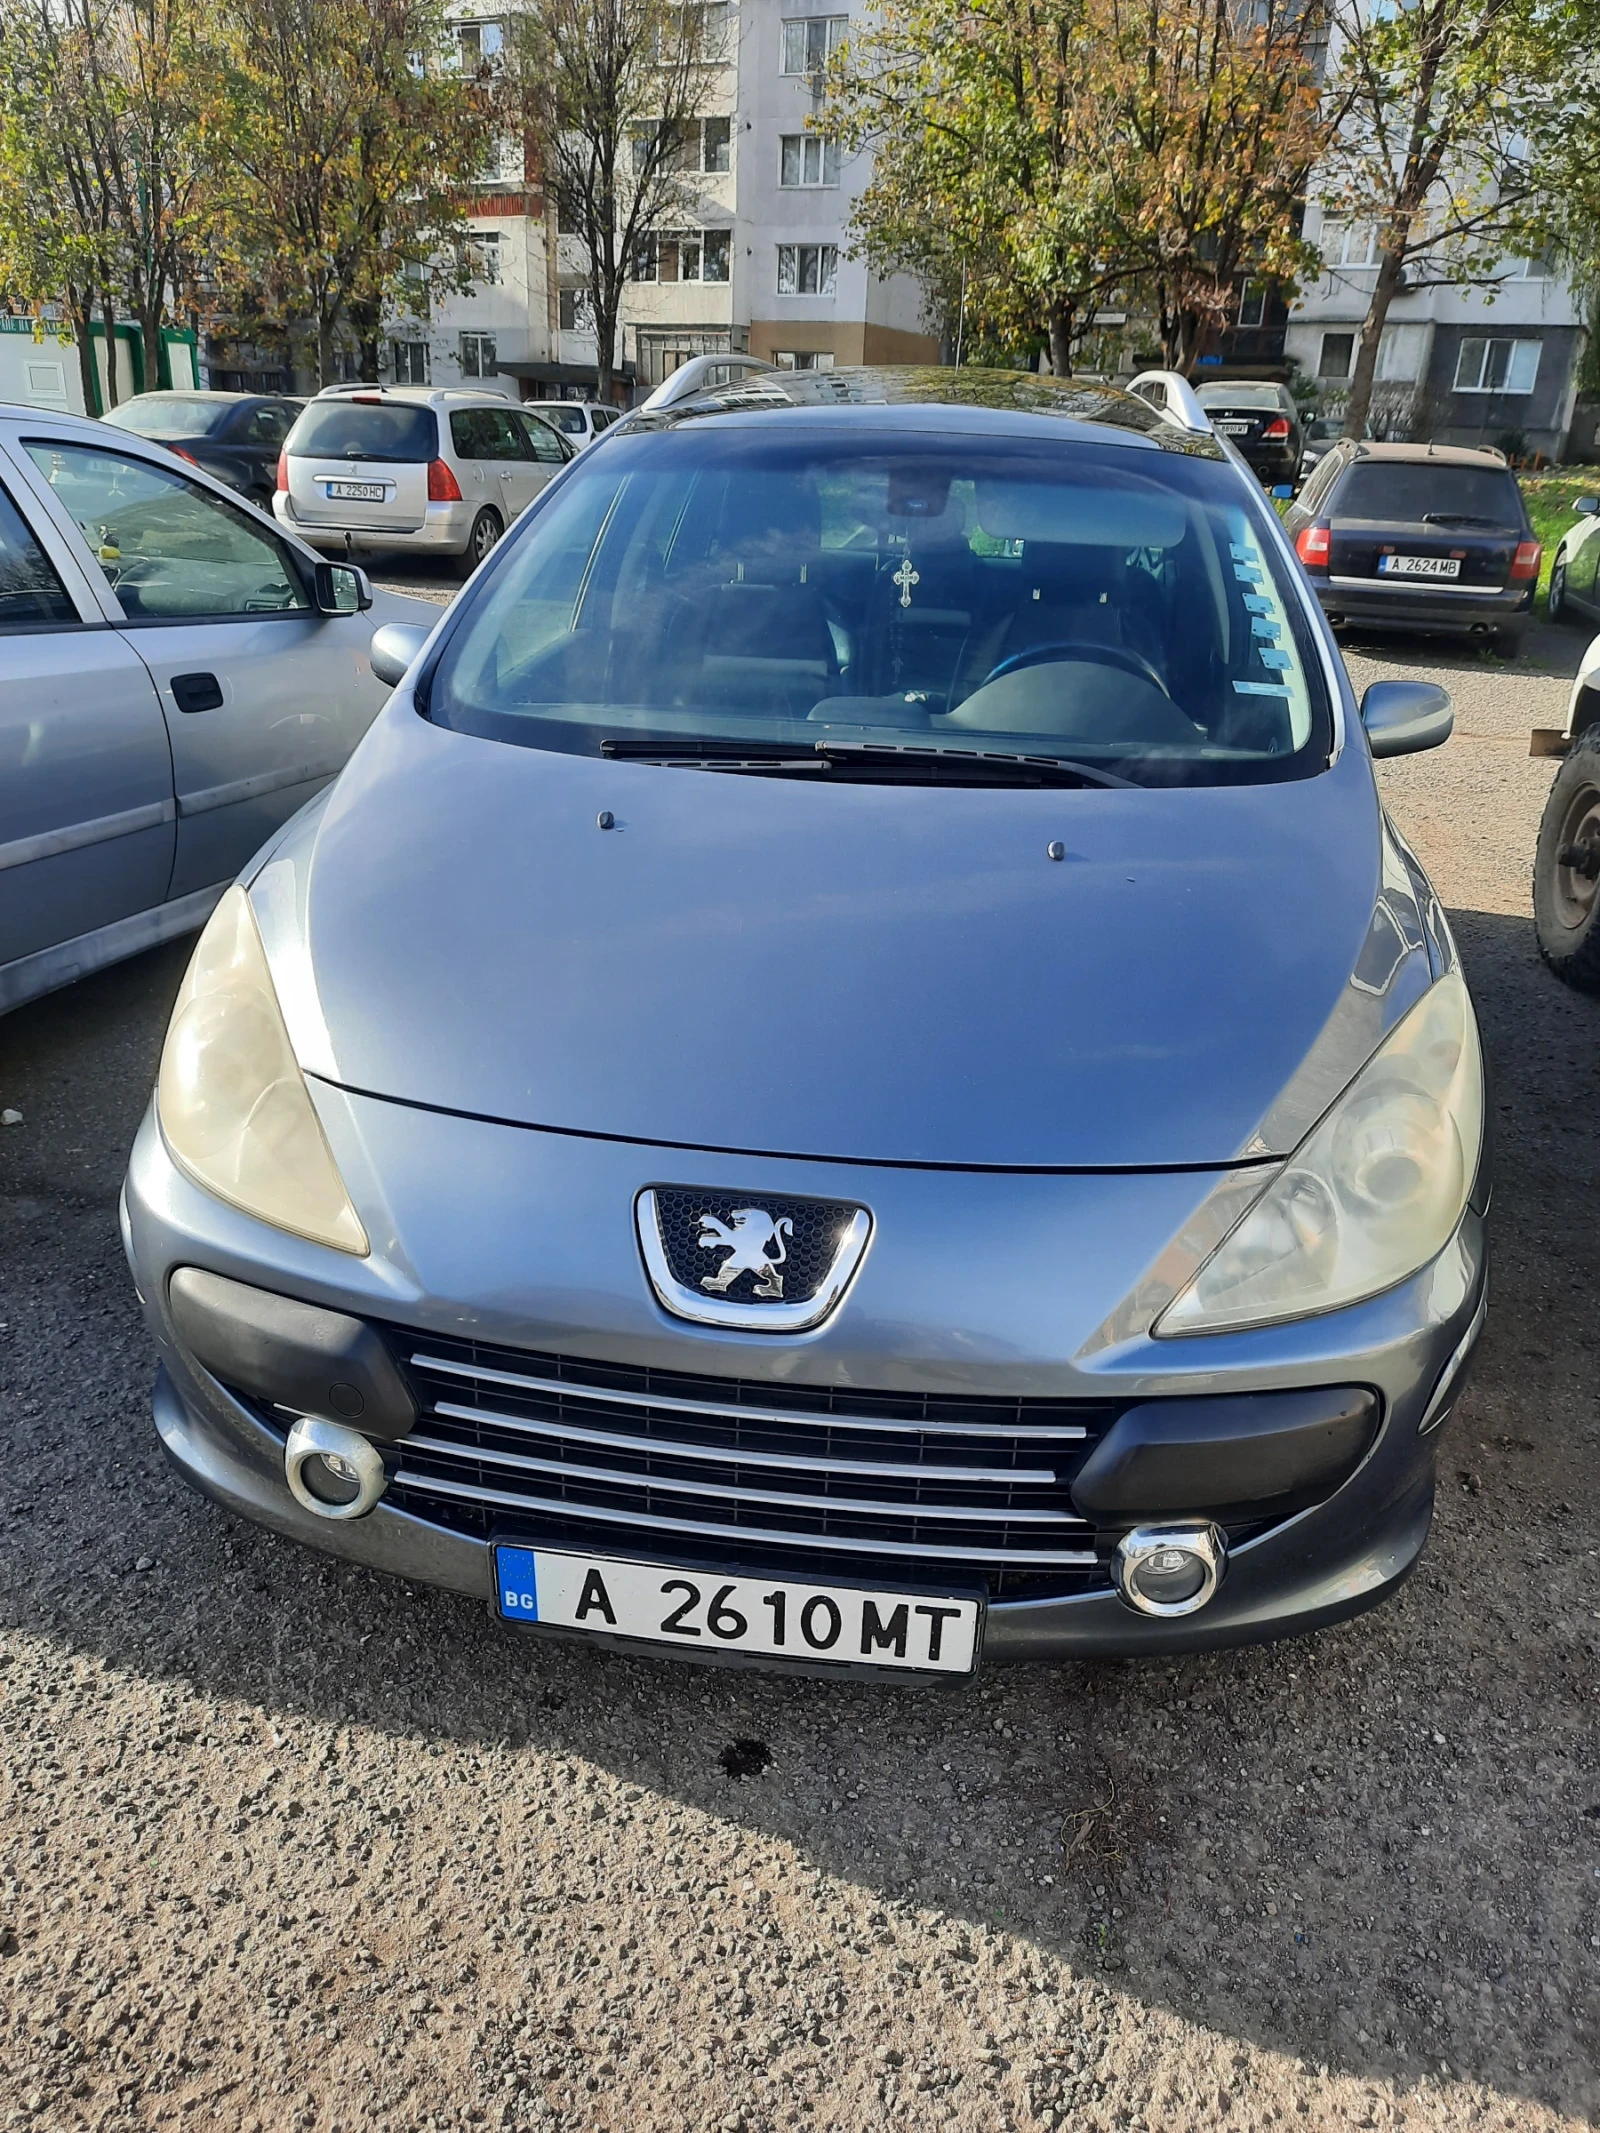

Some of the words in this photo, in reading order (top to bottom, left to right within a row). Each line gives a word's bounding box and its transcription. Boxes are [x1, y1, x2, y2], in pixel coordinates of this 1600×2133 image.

[336, 485, 342, 495] A
[346, 486, 368, 497] 2250
[369, 487, 381, 497] HC
[1391, 558, 1400, 570] A
[1406, 559, 1438, 572] 2624
[1438, 561, 1457, 574] MB
[505, 1591, 534, 1610] BG
[575, 1569, 617, 1624] A
[660, 1579, 842, 1650] 2610
[860, 1600, 962, 1661] MT
